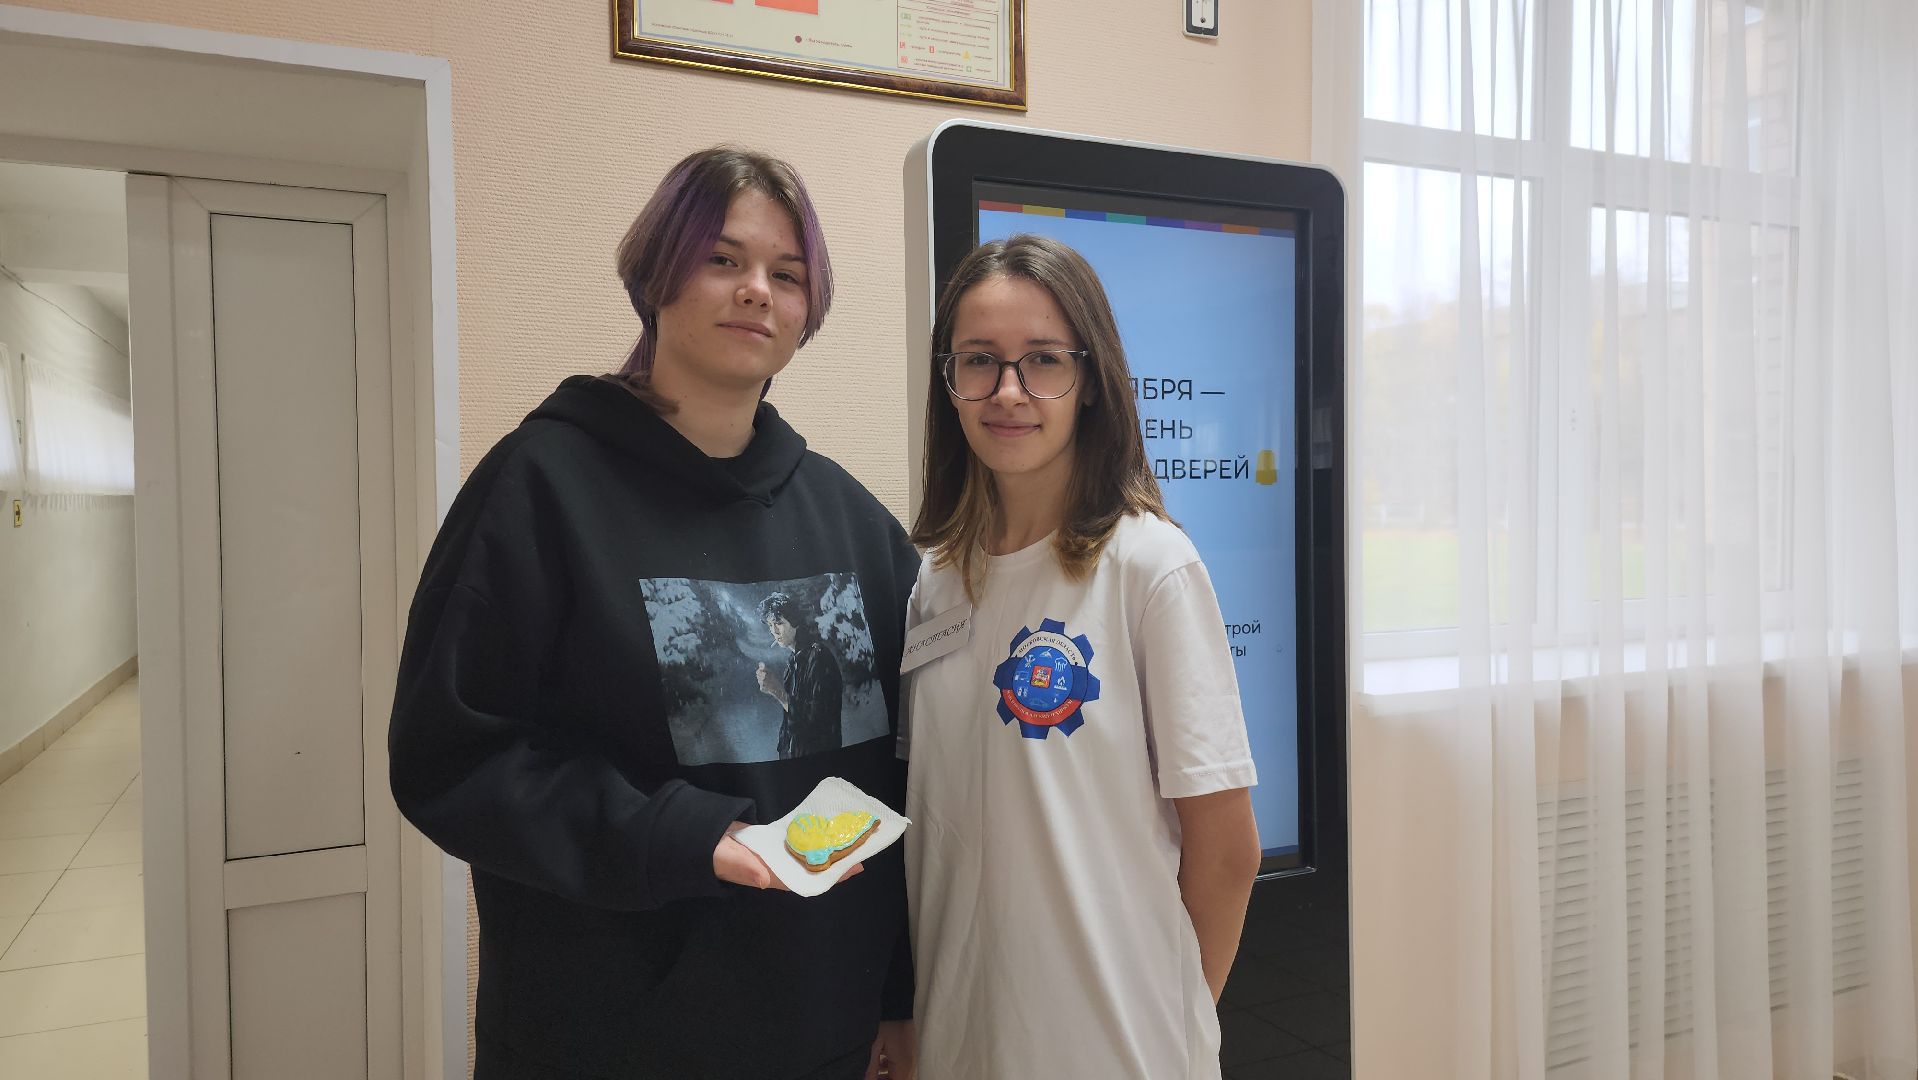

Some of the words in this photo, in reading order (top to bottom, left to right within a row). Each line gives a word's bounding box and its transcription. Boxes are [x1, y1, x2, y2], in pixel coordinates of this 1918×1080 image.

[1144, 418, 1194, 440] ЕНЬ
[1154, 453, 1250, 484] ДВЕРЕЙ
[1224, 619, 1261, 639] трой
